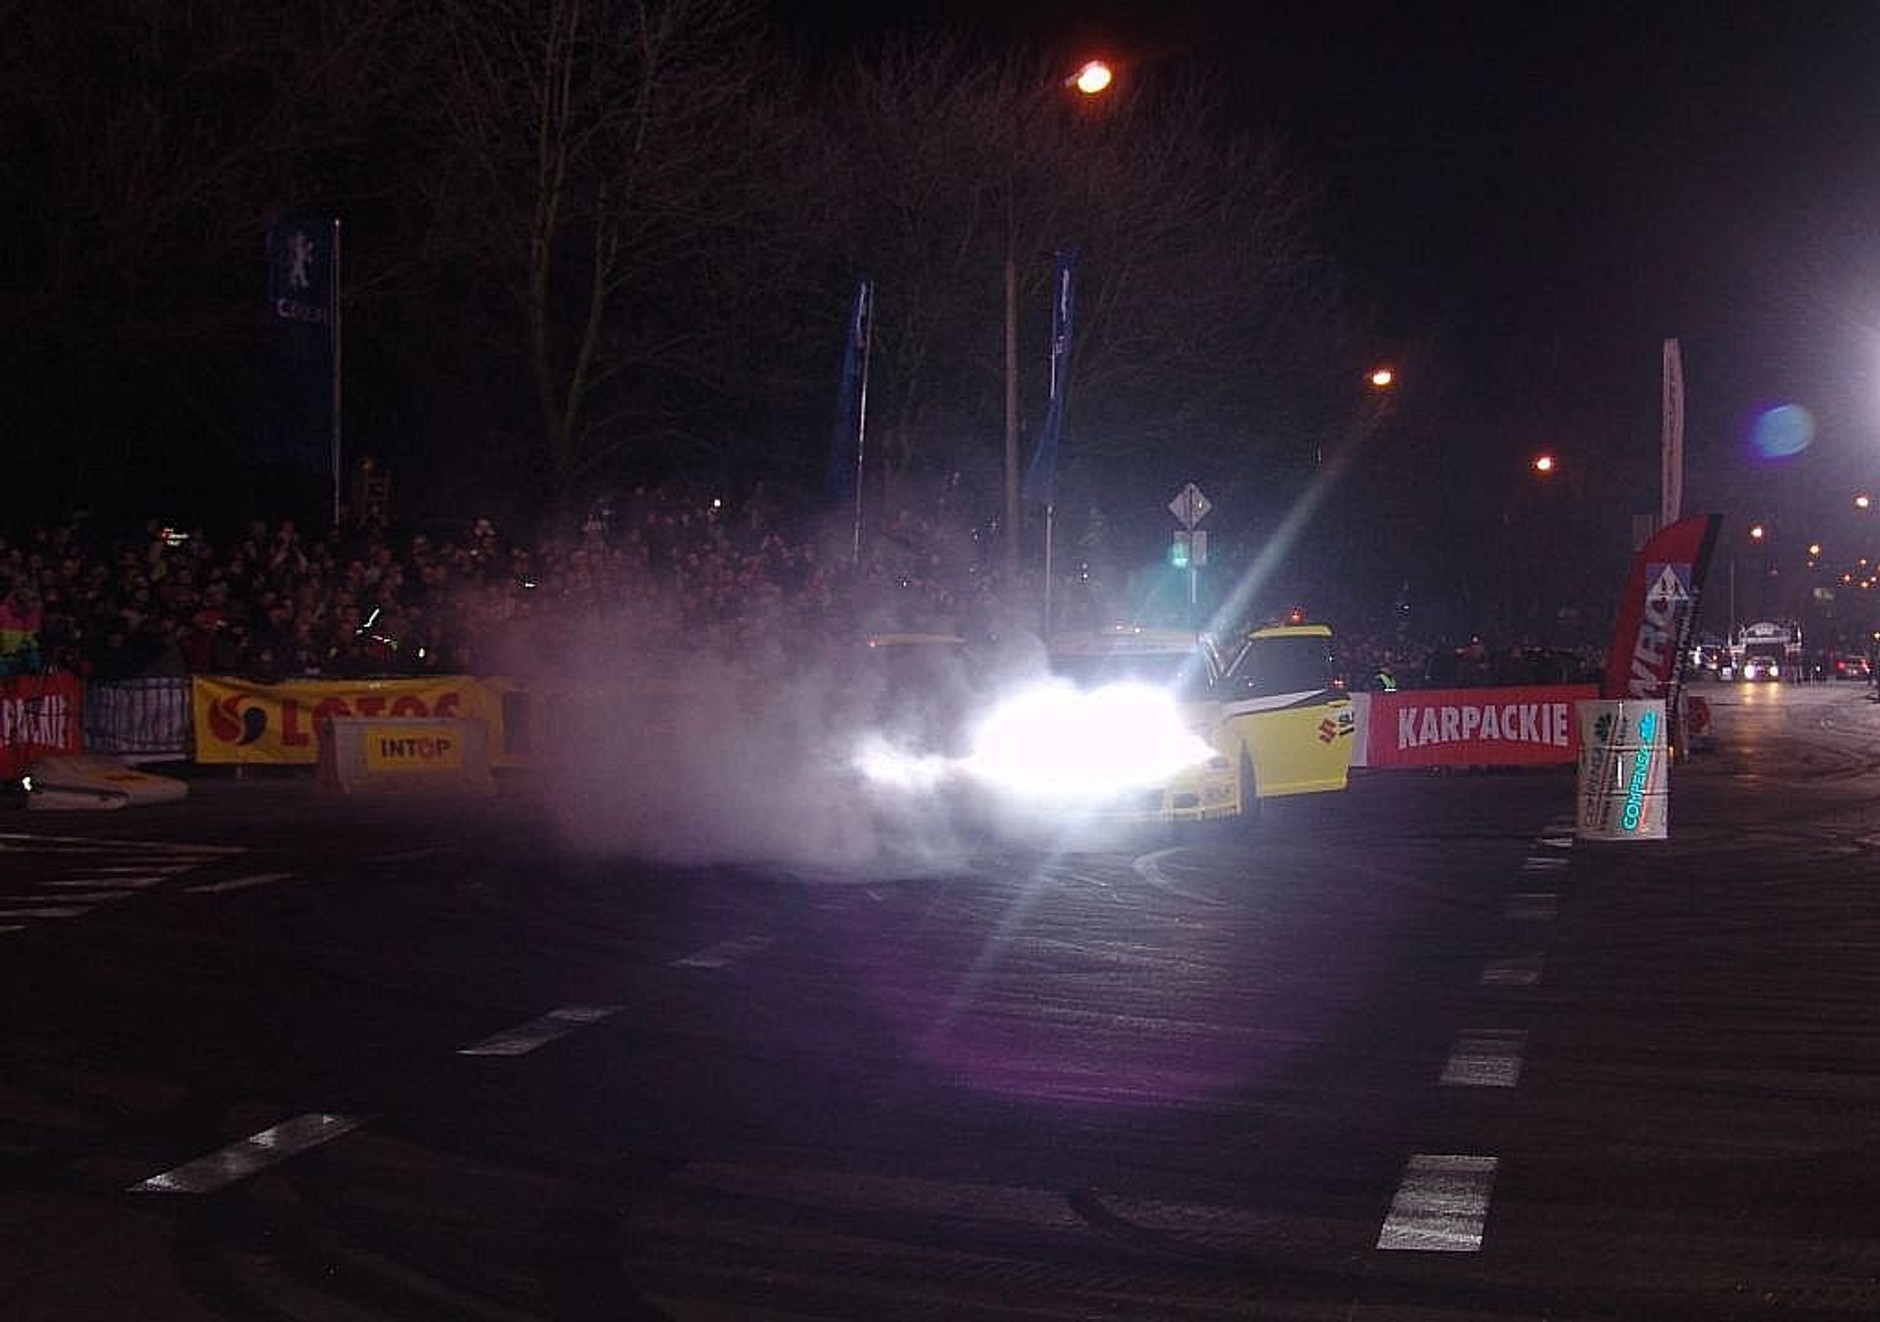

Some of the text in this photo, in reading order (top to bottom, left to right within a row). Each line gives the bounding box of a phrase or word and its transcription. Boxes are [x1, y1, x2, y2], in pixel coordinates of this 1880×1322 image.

[381, 738, 452, 759] INTOP
[1398, 703, 1570, 750] KARPACKIE
[1622, 745, 1649, 831] COMPENSA
